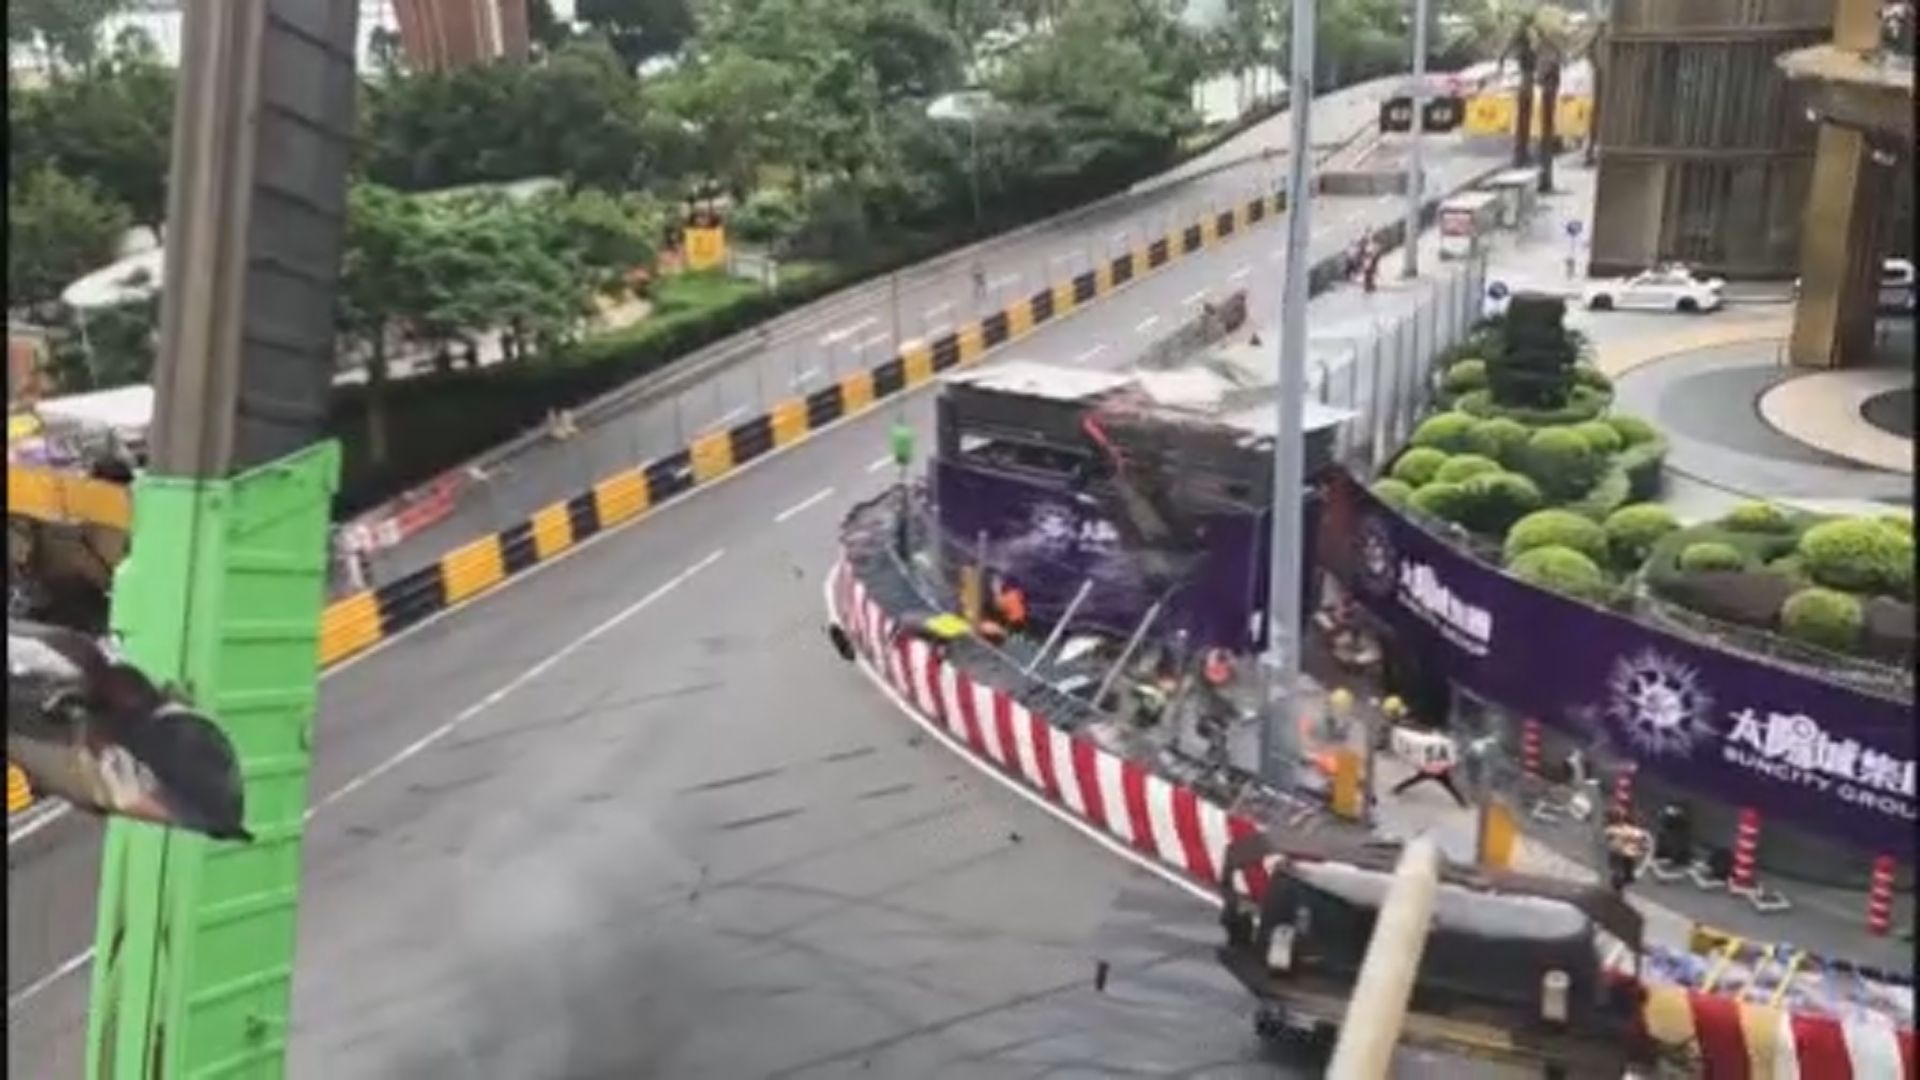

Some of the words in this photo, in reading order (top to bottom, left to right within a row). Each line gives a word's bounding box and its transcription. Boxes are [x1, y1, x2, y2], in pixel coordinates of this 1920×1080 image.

[1723, 746, 1831, 790] SUNCITY
[1727, 707, 1916, 796] 太陽城集
